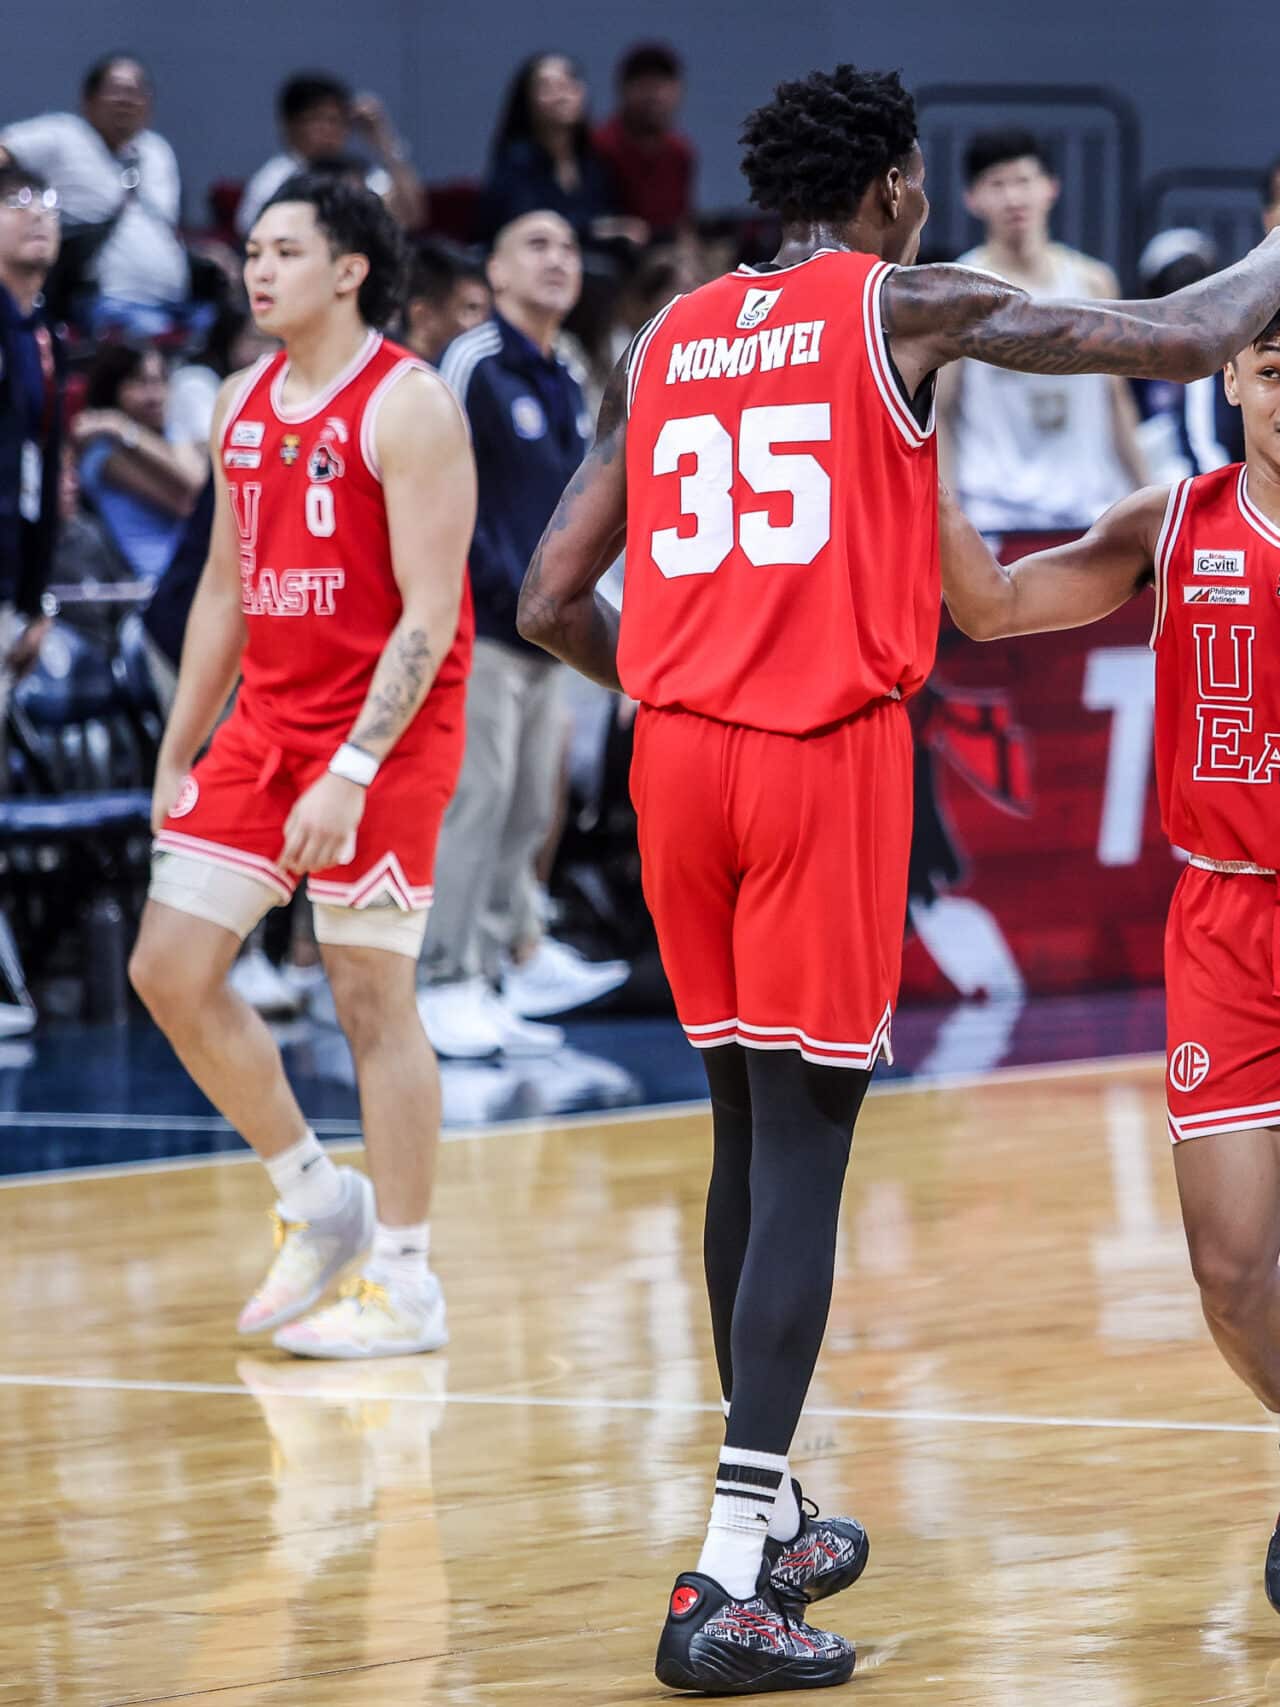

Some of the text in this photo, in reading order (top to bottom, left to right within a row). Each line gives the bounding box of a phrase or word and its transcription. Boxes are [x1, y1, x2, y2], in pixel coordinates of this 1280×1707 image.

[665, 320, 825, 384] MOMOWEI
[305, 483, 336, 537] 0
[651, 402, 831, 579] 35
[1200, 560, 1234, 571] C-vitt
[1210, 587, 1245, 596] Philippine
[1193, 624, 1255, 701] U
